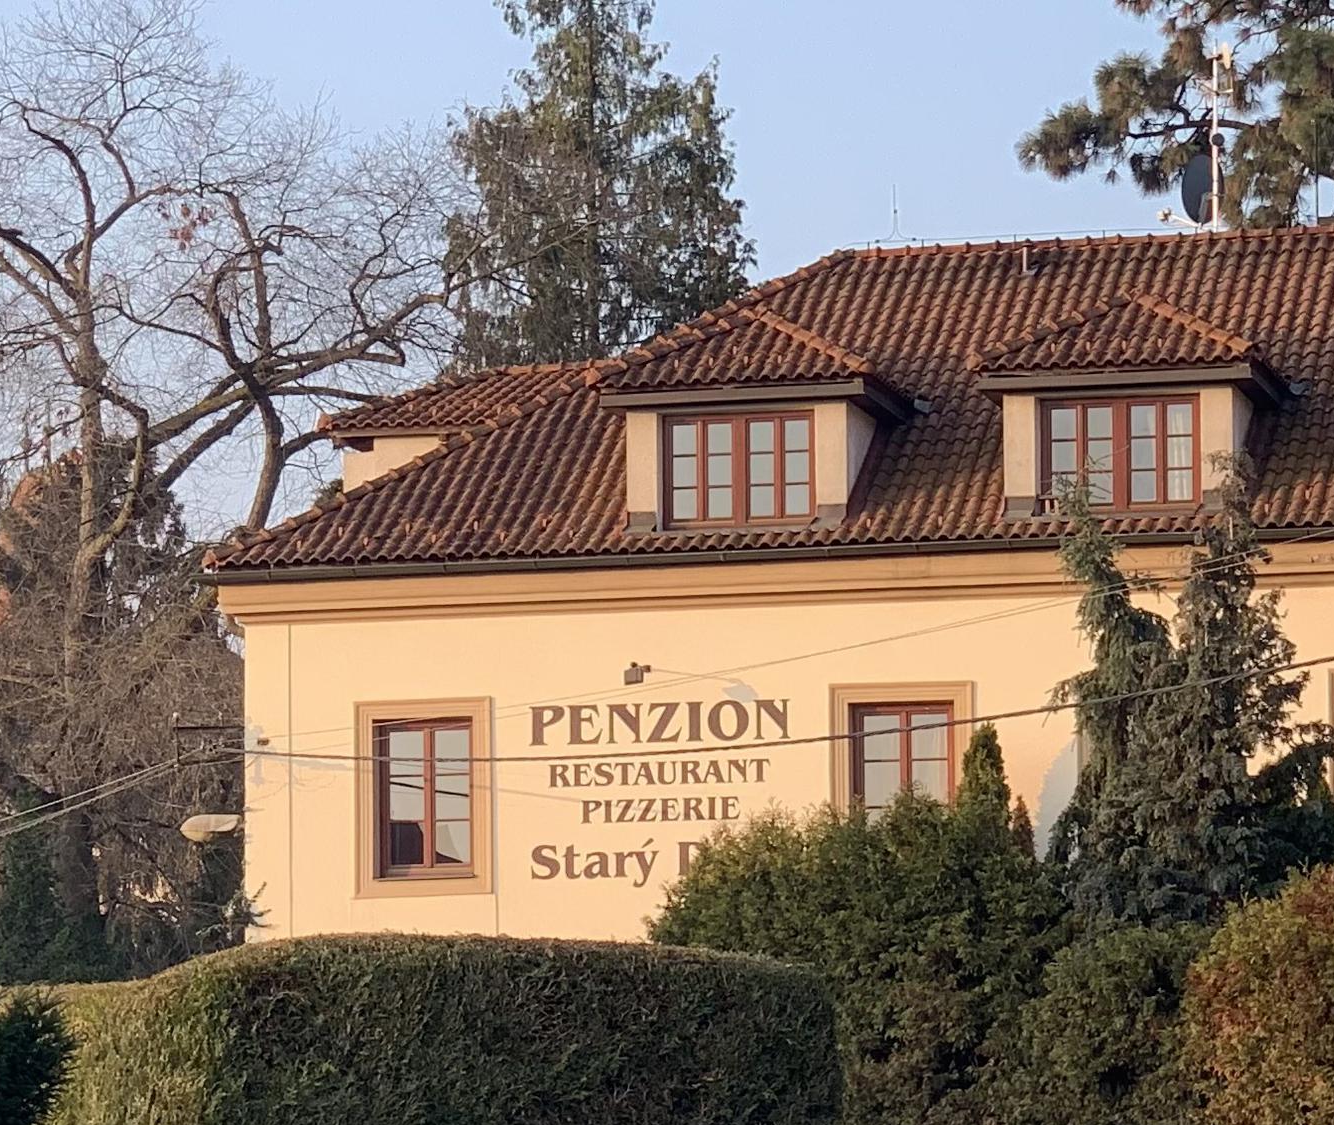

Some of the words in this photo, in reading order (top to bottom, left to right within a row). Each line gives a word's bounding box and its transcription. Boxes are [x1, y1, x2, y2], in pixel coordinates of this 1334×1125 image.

[529, 698, 791, 747] PENZION
[548, 758, 770, 788] RESTAURANT
[581, 796, 741, 824] PIZZERIE
[531, 838, 659, 888] Starý
